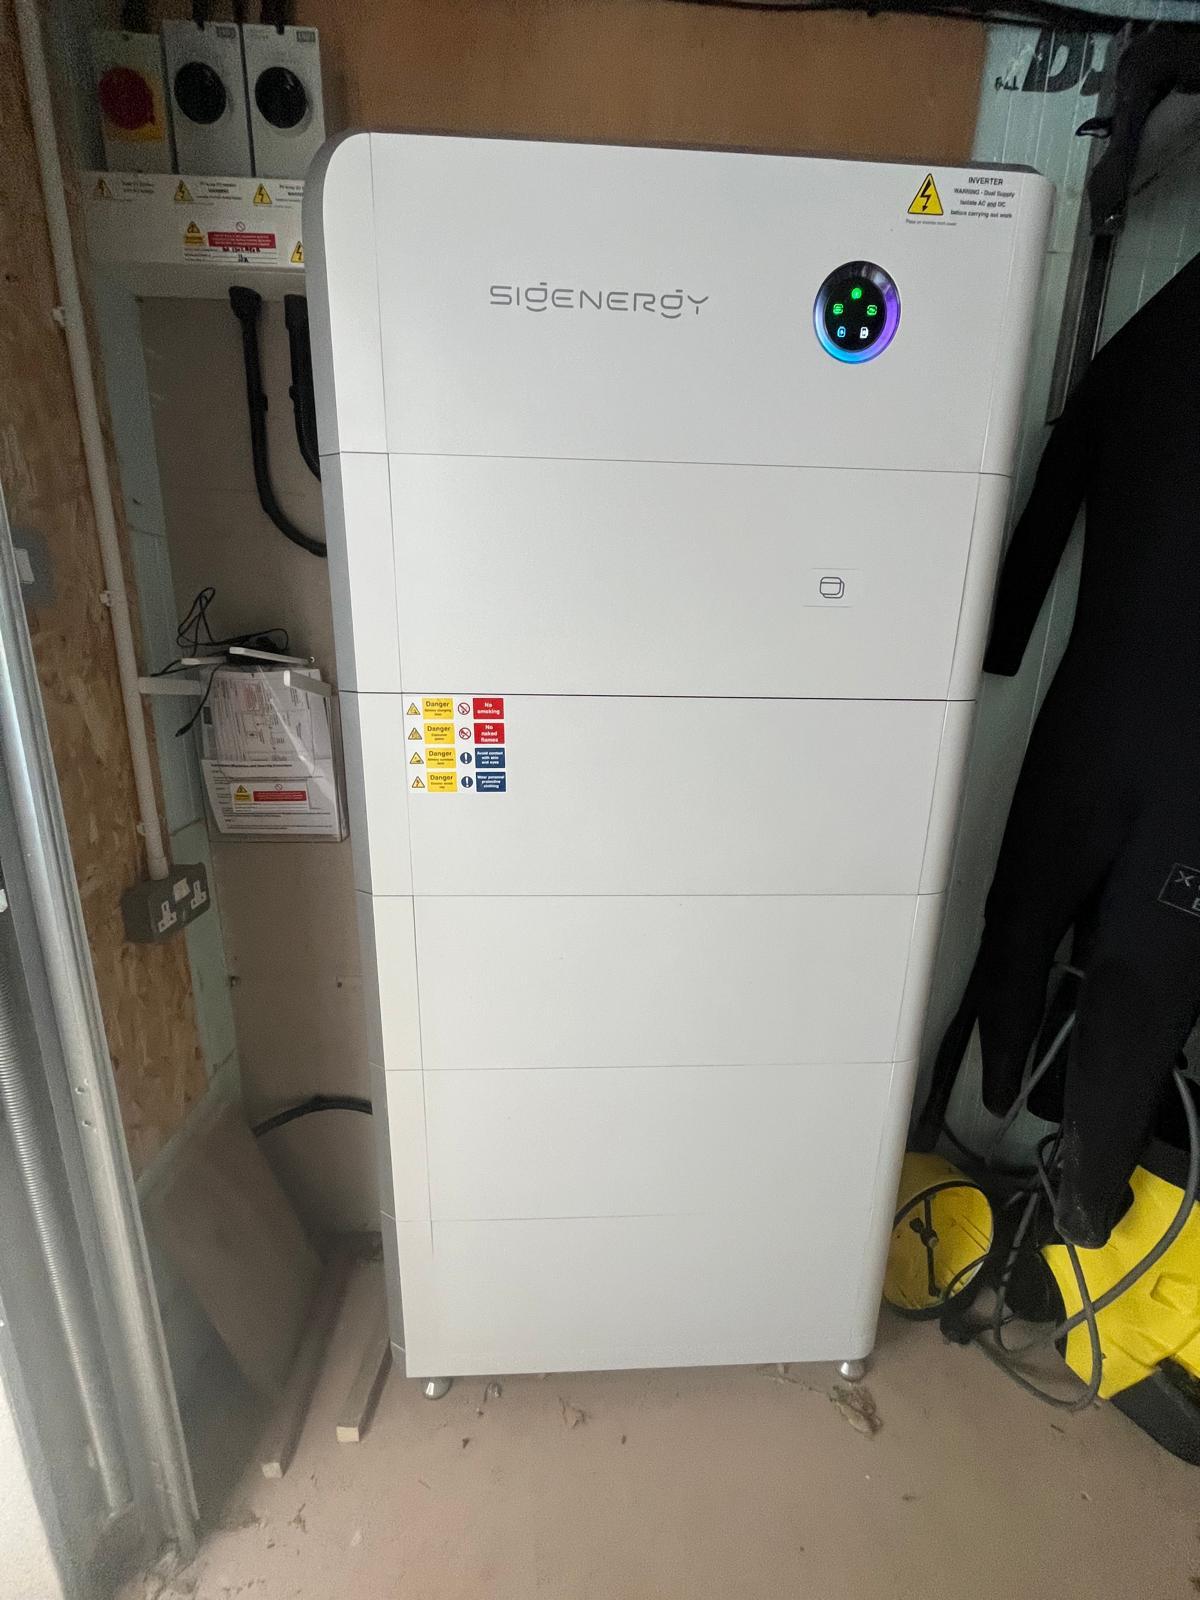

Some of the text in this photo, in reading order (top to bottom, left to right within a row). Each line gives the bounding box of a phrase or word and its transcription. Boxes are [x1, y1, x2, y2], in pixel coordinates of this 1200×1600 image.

[968, 176, 1004, 186] INVERTER
[954, 188, 980, 196] WARNING
[996, 190, 1015, 198] Supply
[968, 210, 990, 218] carrying
